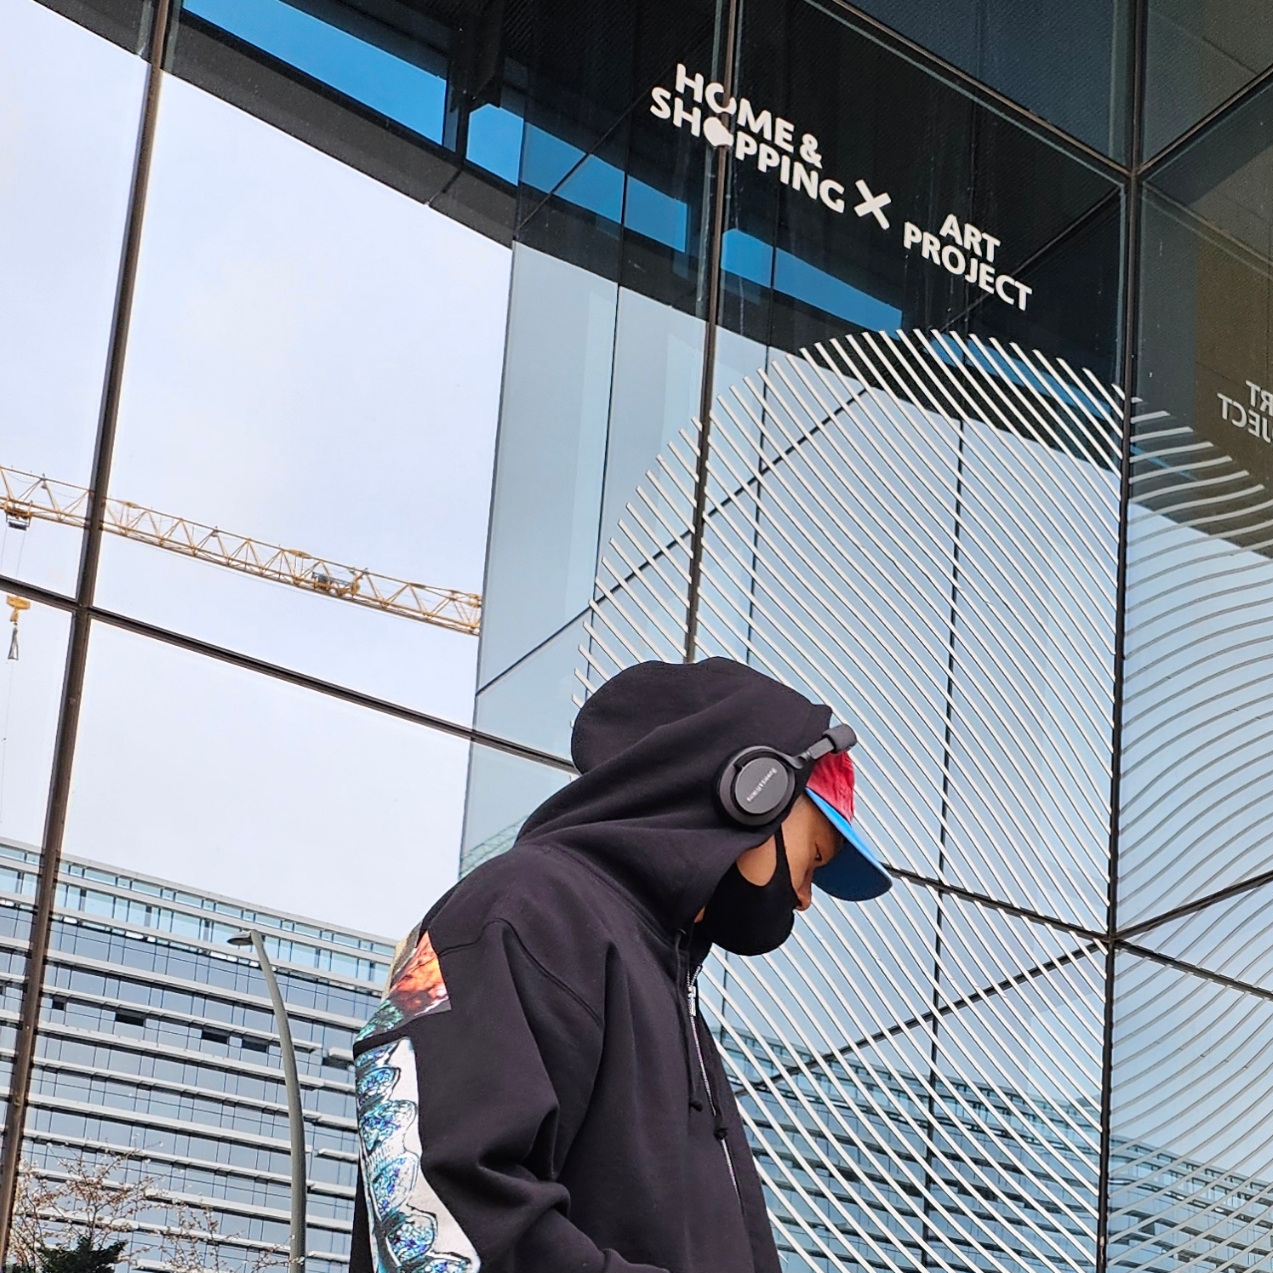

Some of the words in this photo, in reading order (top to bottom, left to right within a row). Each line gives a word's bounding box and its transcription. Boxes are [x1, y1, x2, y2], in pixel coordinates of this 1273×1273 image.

[799, 133, 823, 169] &
[939, 213, 1001, 263] ART
[903, 221, 1033, 311] PROJECT
